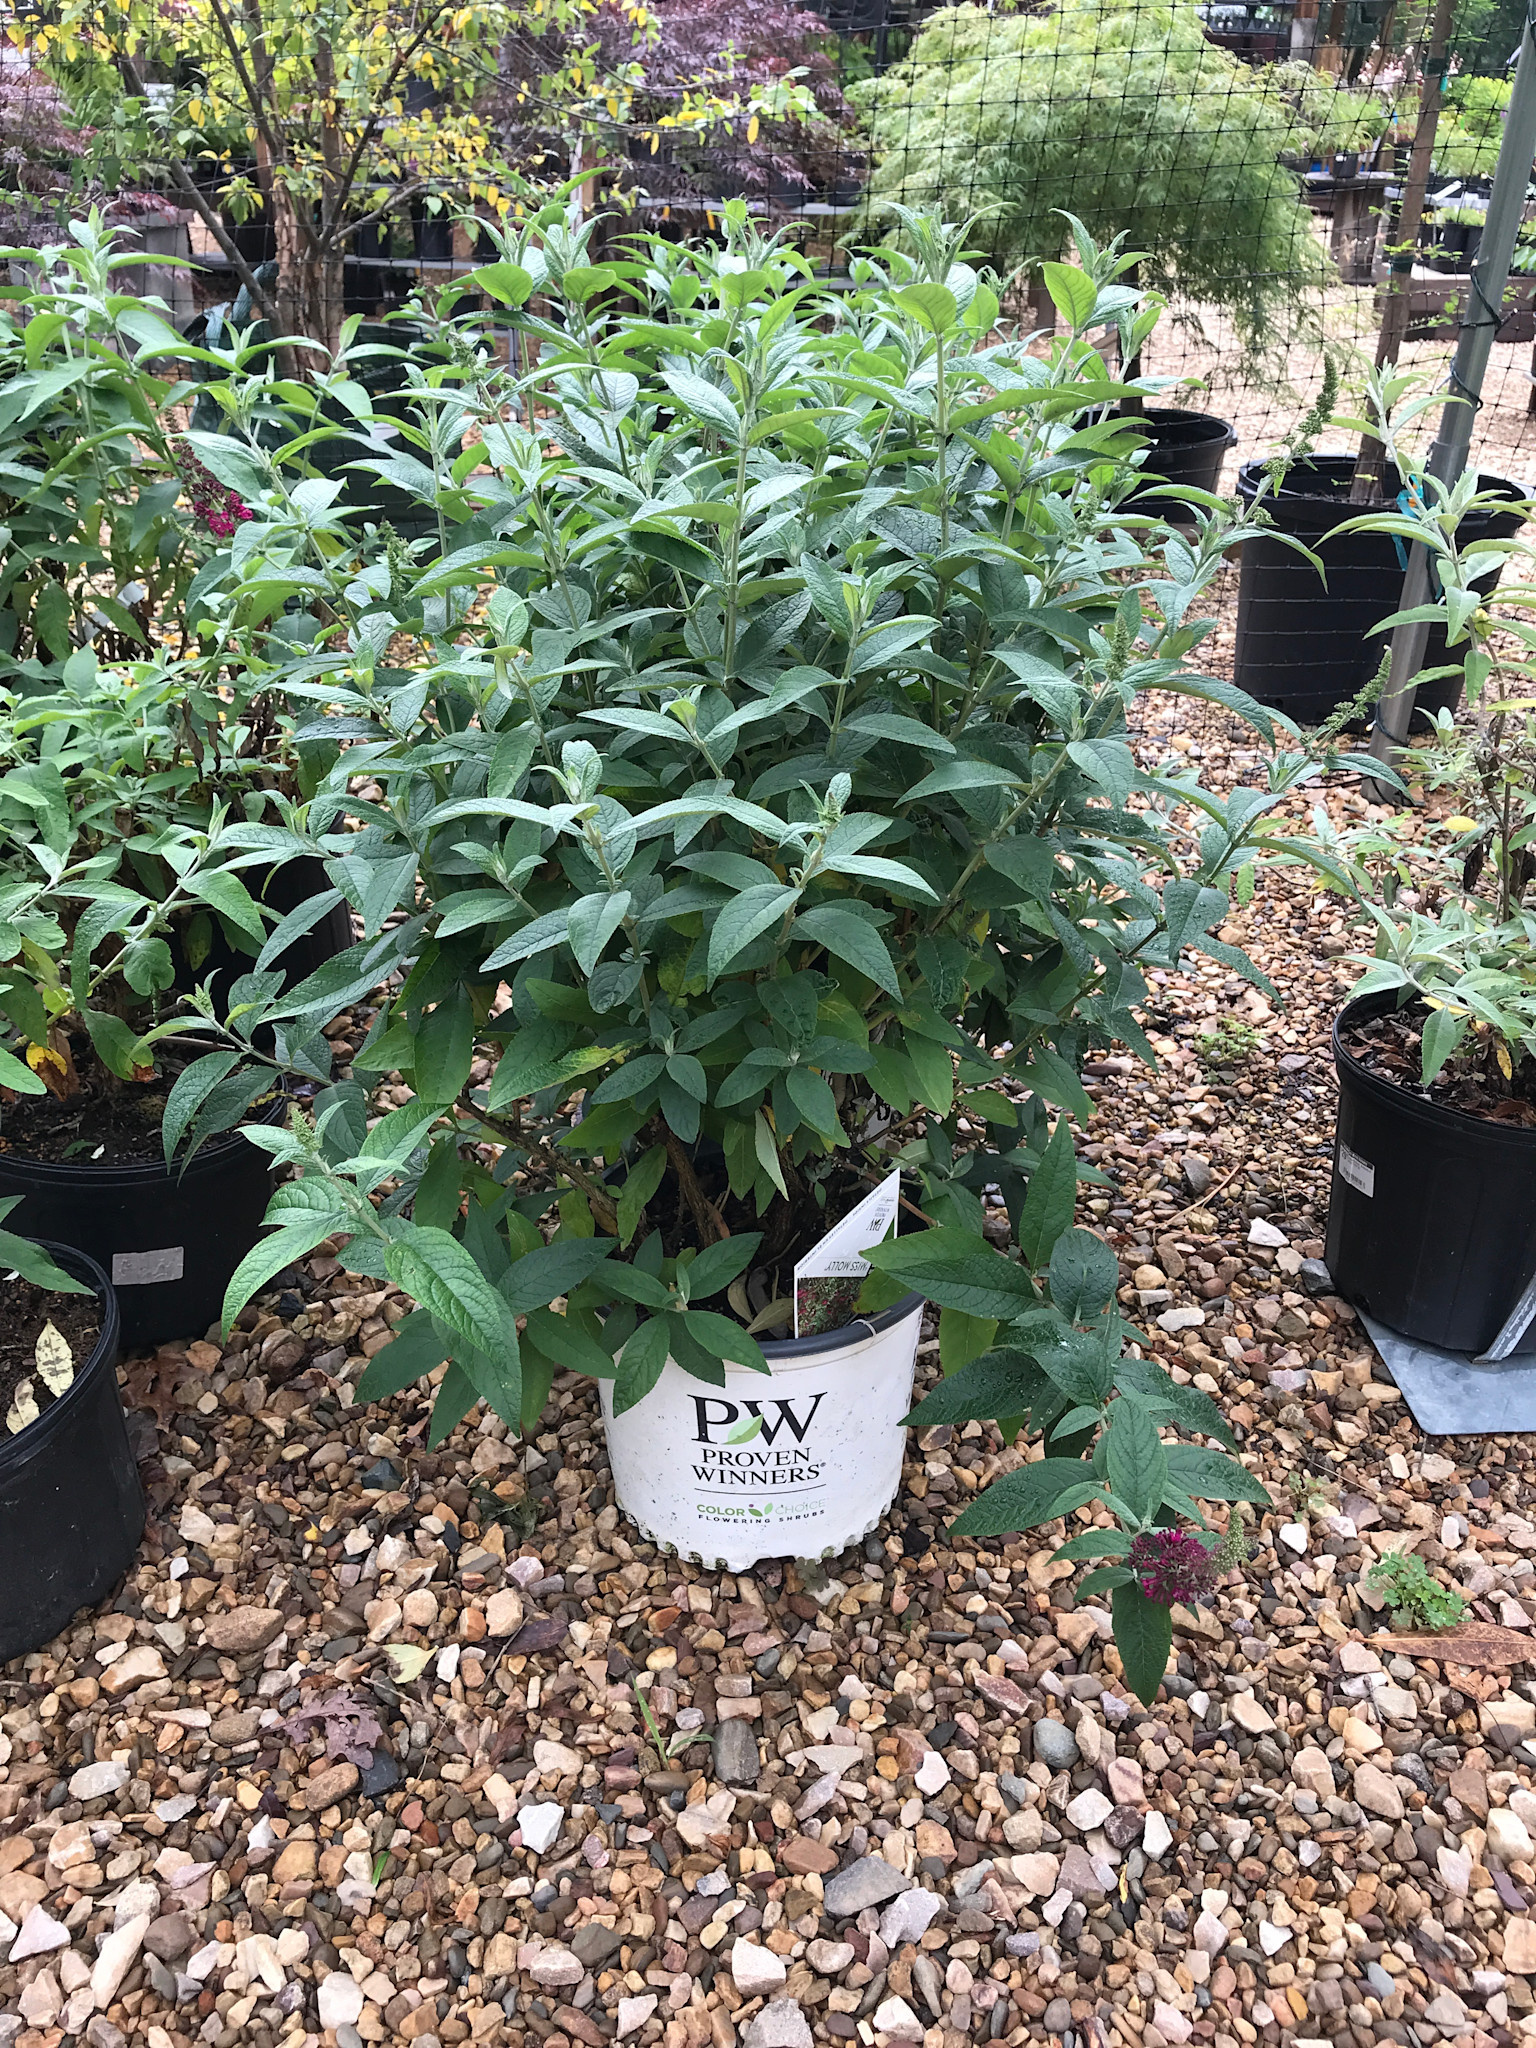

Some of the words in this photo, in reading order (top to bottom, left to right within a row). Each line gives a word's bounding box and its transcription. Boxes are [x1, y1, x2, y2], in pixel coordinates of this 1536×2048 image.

[686, 1391, 828, 1447] PW
[700, 1447, 812, 1467] PROVEN
[696, 1504, 746, 1517] COLOR
[774, 1498, 827, 1516] CHOICE
[698, 1514, 771, 1524] FLOWERING
[778, 1509, 825, 1522] SHRUBS
